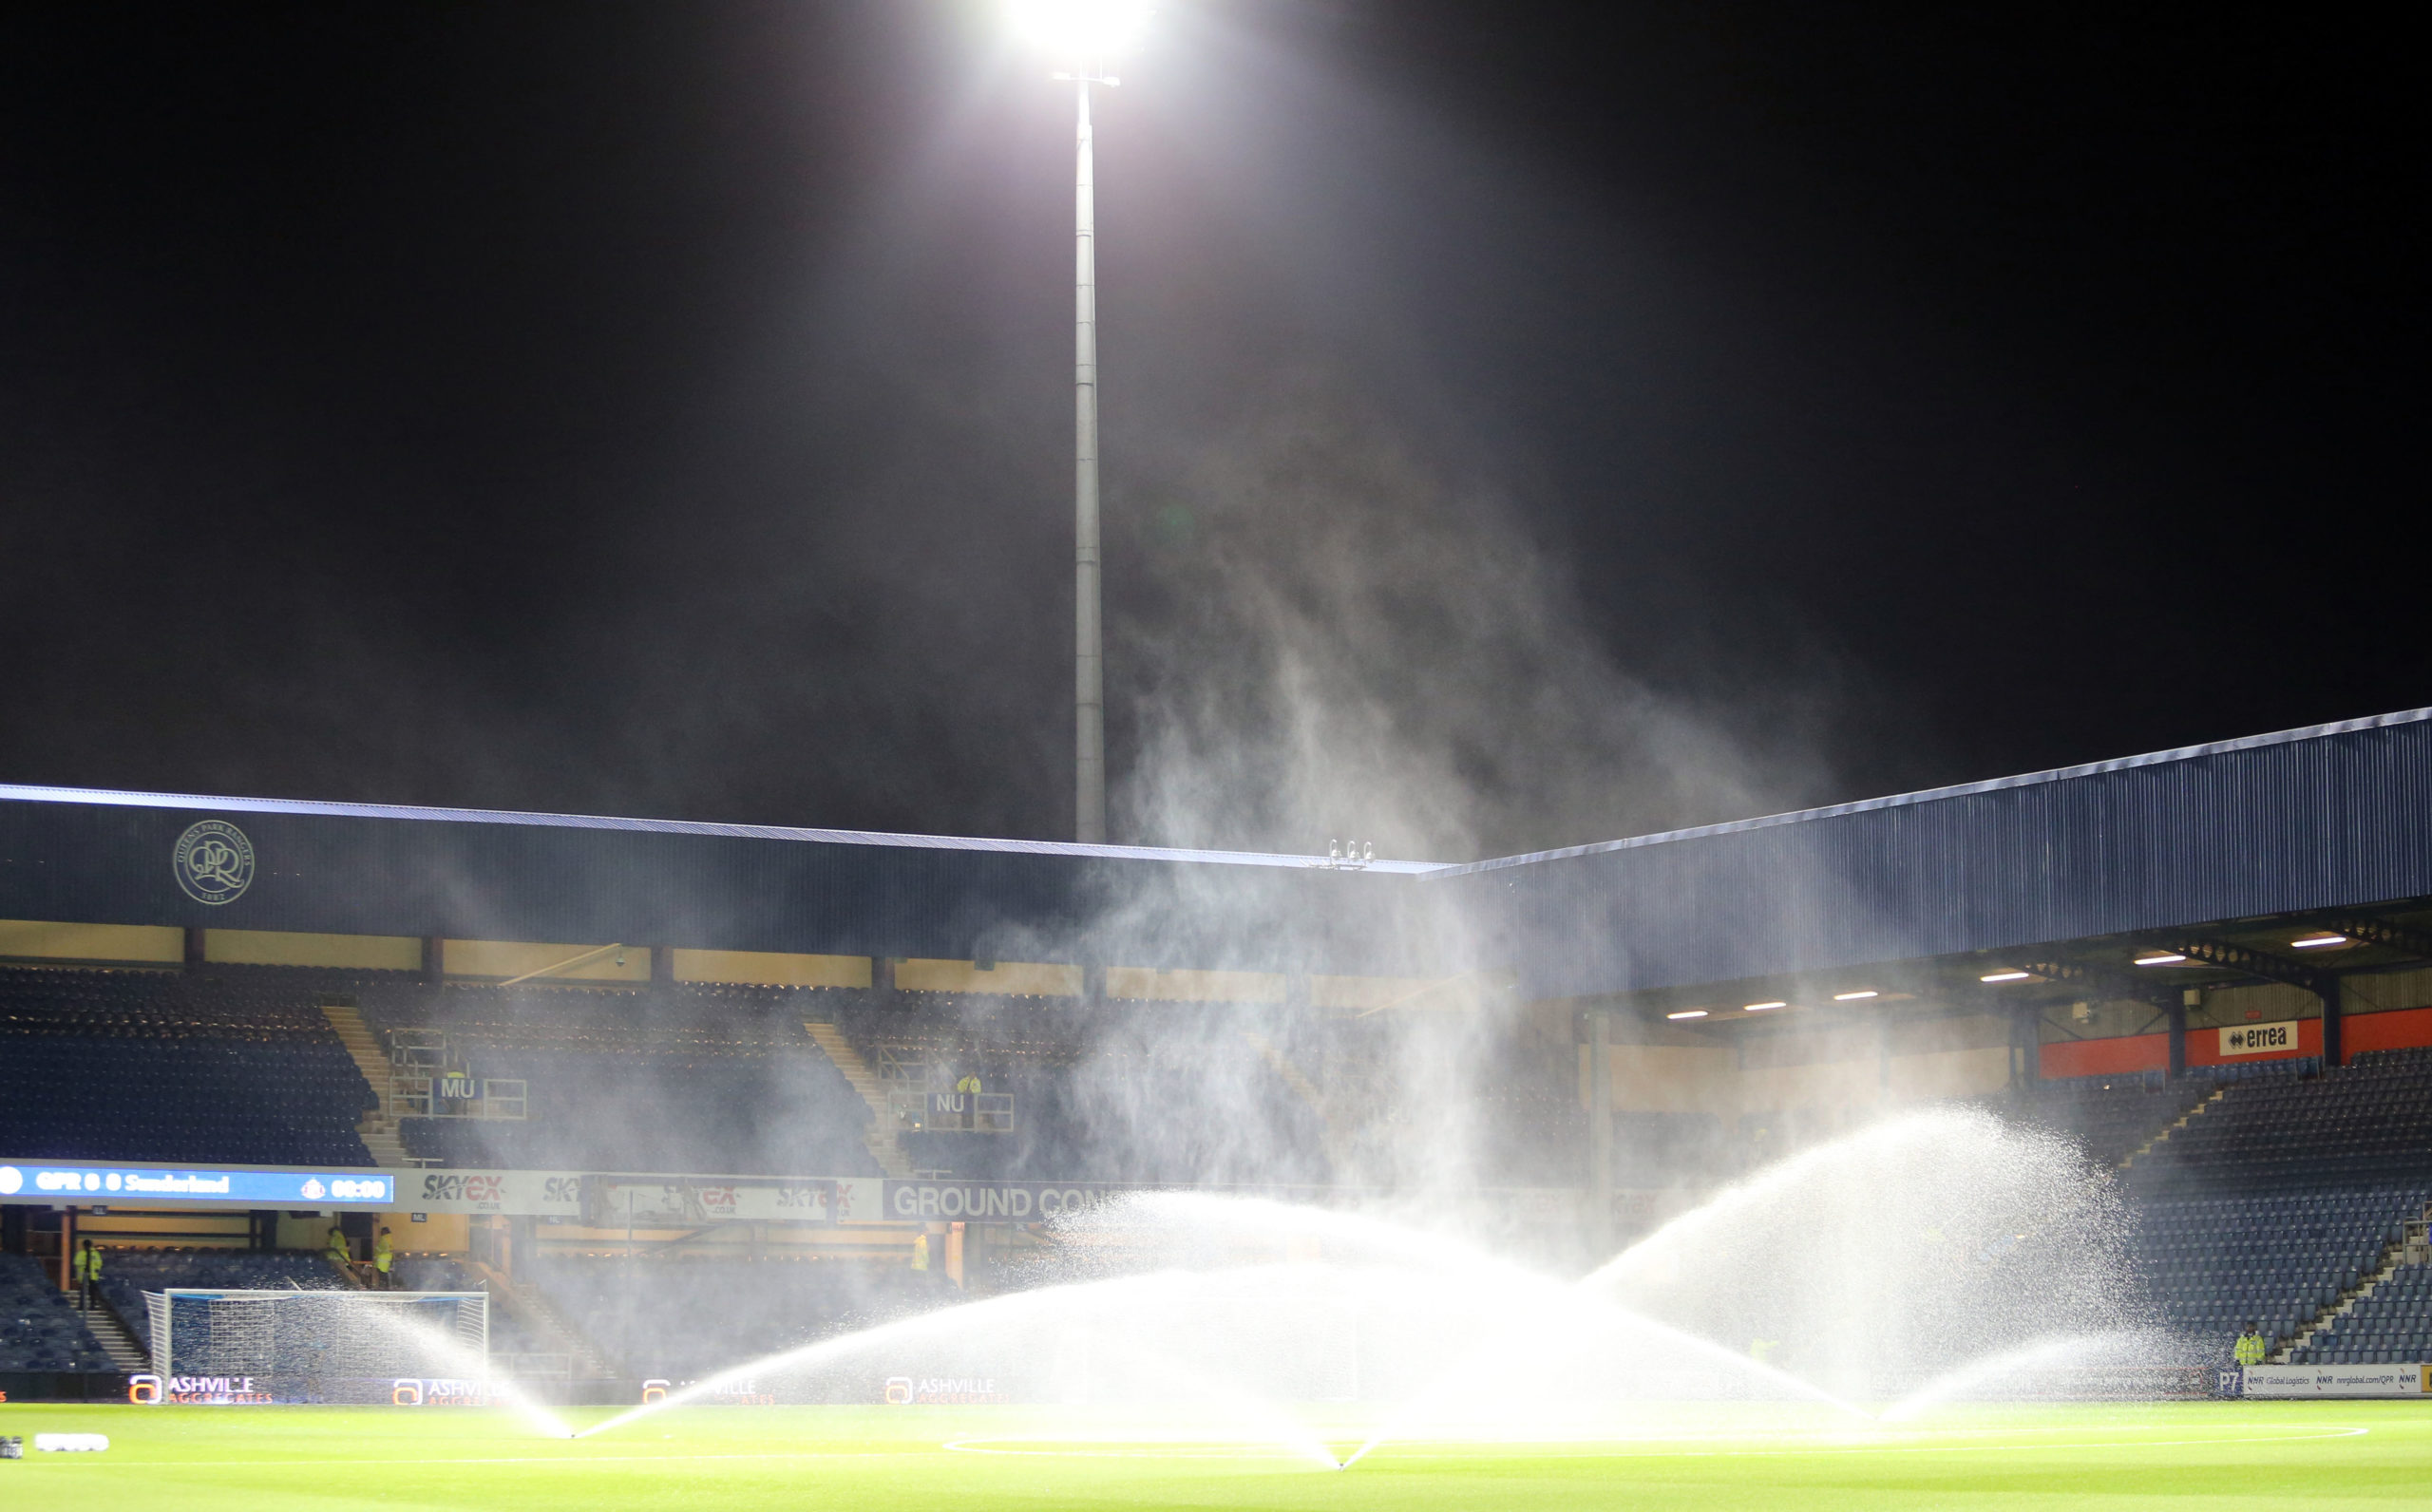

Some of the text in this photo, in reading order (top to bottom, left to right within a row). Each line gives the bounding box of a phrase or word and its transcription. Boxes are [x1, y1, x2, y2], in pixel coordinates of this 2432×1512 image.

[441, 1079, 474, 1098] MU
[937, 1094, 964, 1112] NU
[124, 1174, 229, 1193] Sunderland
[331, 1180, 385, 1199] 00:00
[894, 1186, 1032, 1217] GROUND
[919, 1378, 995, 1393] ASHVILLE
[2219, 1372, 2239, 1391] P7
[2267, 1376, 2285, 1385] Global
[2286, 1376, 2309, 1387] Logistics
[2316, 1375, 2333, 1385] NNR
[2337, 1375, 2394, 1386] nnrglobal.com/QPR
[2399, 1374, 2417, 1384] NNR
